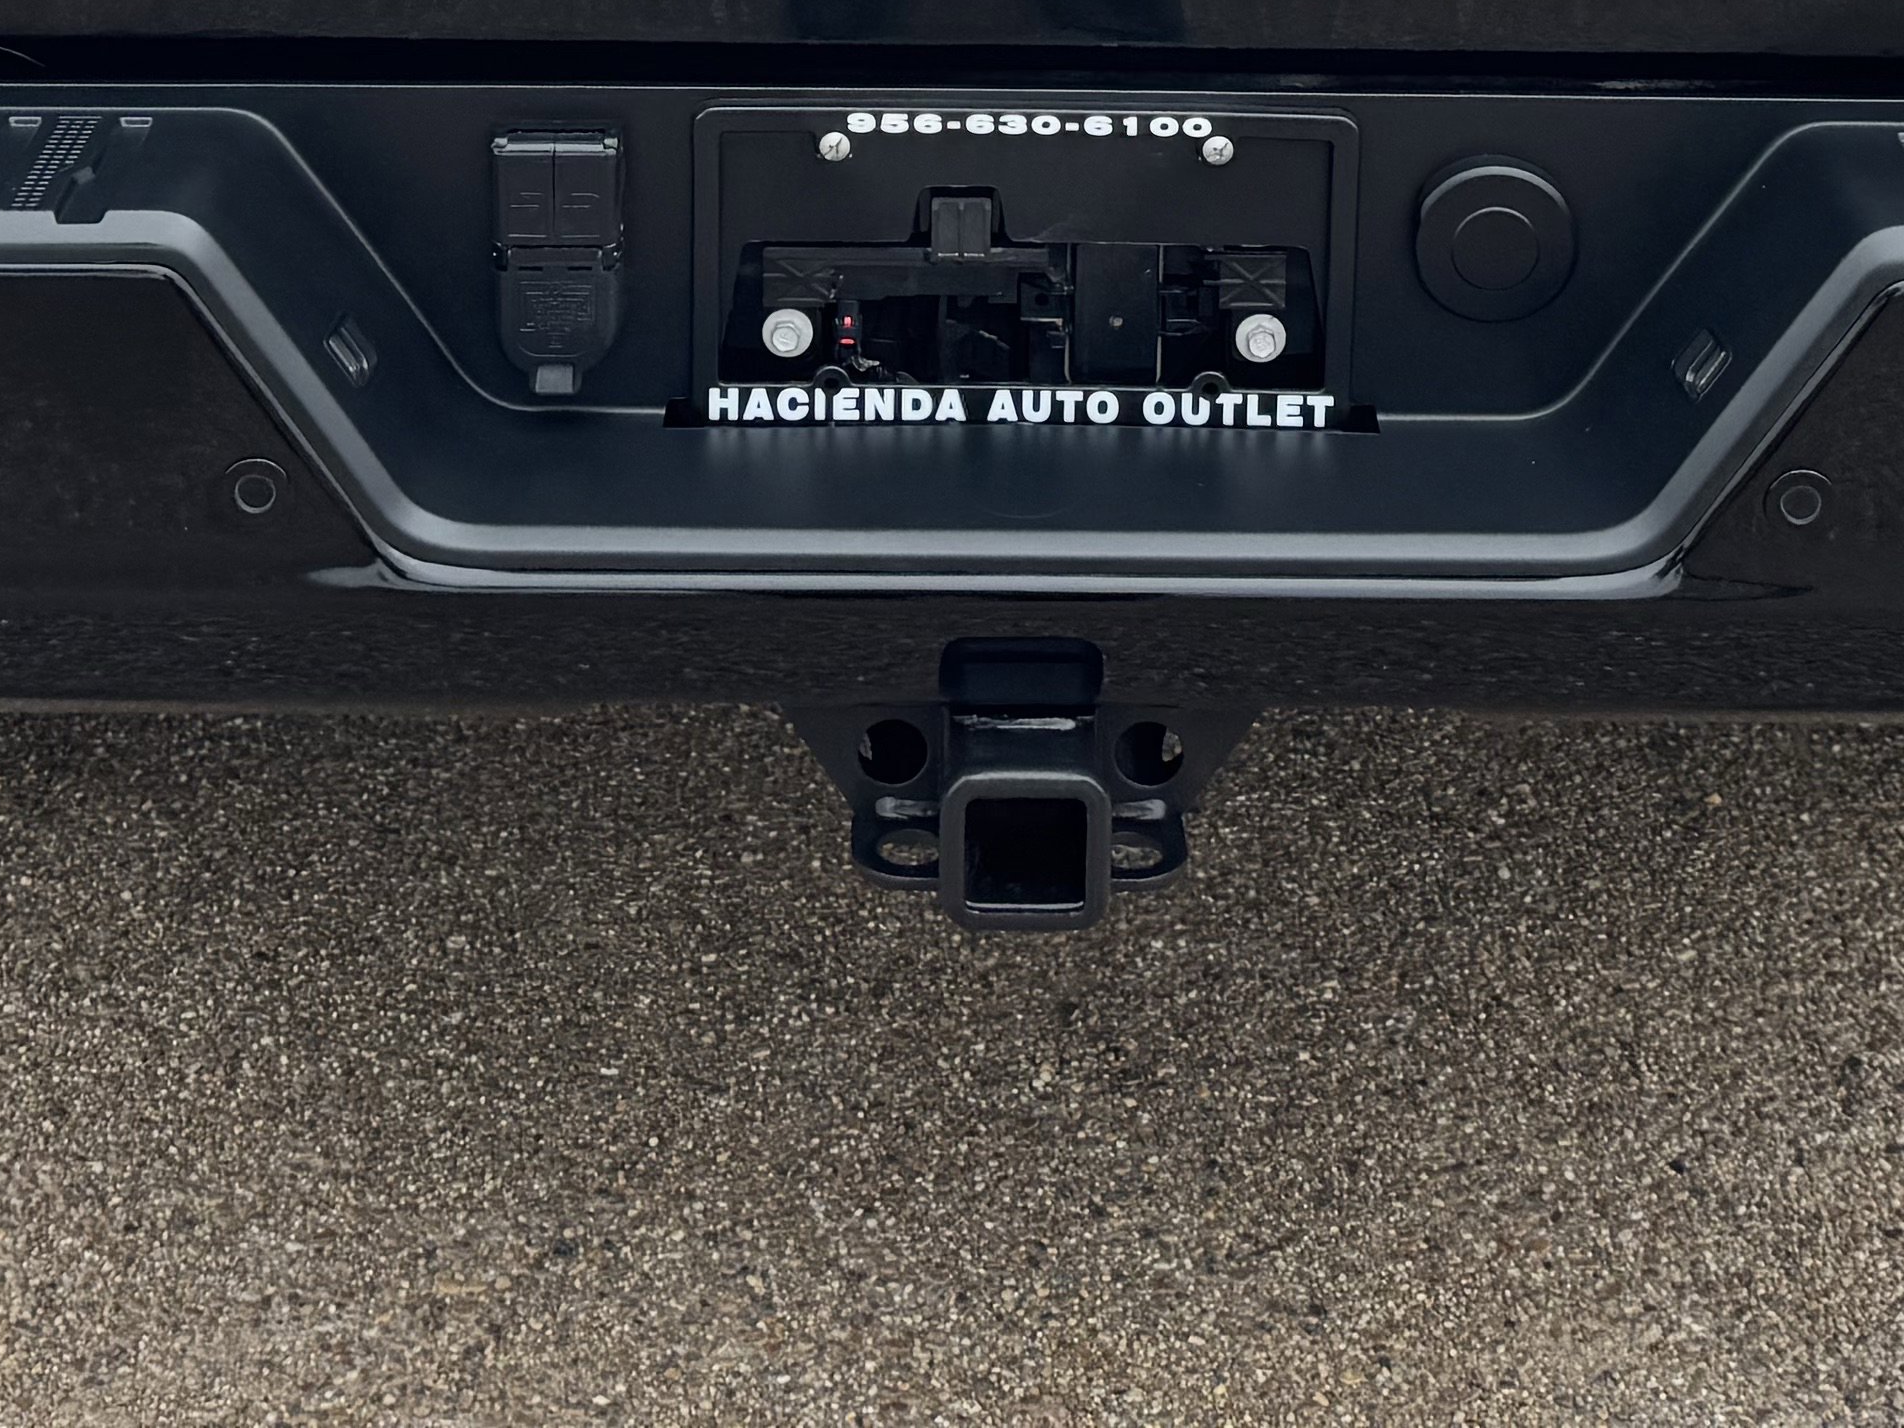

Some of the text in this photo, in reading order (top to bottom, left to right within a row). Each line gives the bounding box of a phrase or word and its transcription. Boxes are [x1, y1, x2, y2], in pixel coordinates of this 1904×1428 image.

[846, 112, 1213, 138] 956-630-6100
[708, 387, 1336, 428] HACIENDA AUTO OUTLET
